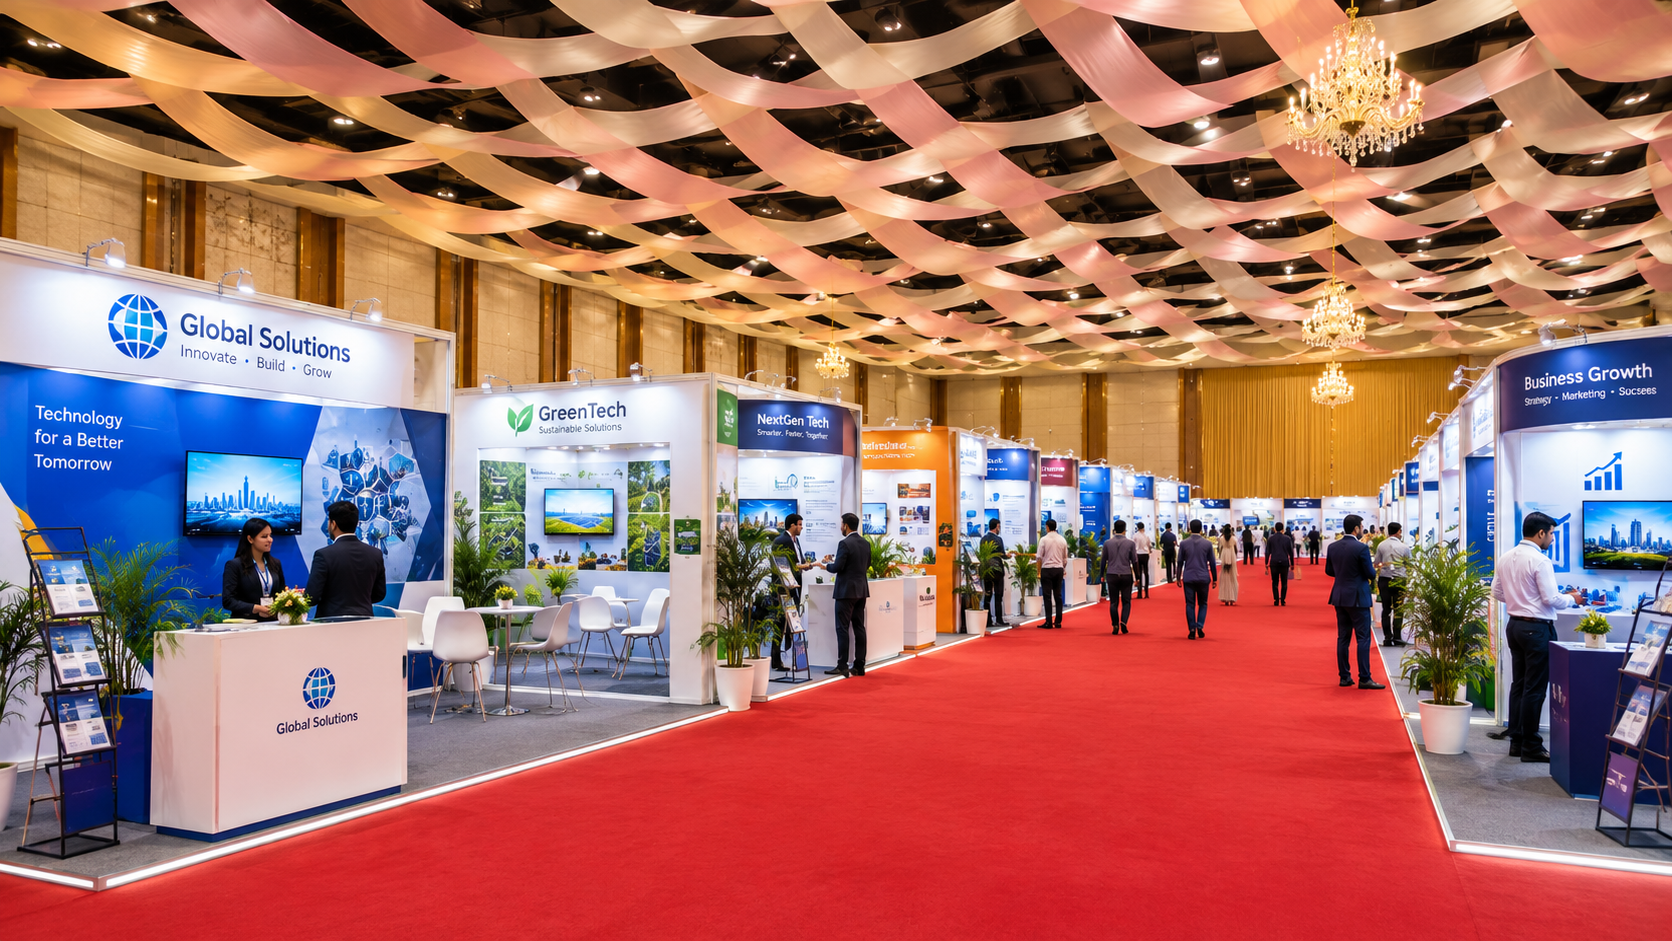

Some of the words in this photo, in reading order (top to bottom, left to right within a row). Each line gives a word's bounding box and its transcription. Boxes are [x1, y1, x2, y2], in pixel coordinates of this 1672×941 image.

[180, 312, 253, 347] Global
[259, 326, 351, 363] Solutions
[180, 344, 237, 365] Innovate
[256, 356, 286, 372] Build
[303, 363, 332, 379] Grow
[1524, 371, 1584, 391] Business
[1588, 362, 1653, 382] Growth
[34, 404, 123, 430] Technology
[538, 400, 627, 422] GreenTech
[757, 413, 804, 427] NextGen
[806, 415, 829, 429] Tech
[34, 428, 59, 445] for
[62, 434, 72, 446] a
[77, 432, 124, 450] Better
[538, 425, 582, 435] Sustainable
[584, 423, 622, 433] Solutions
[33, 453, 112, 471] Tomorrow
[276, 717, 311, 735] Global
[312, 711, 359, 728] Solutions
